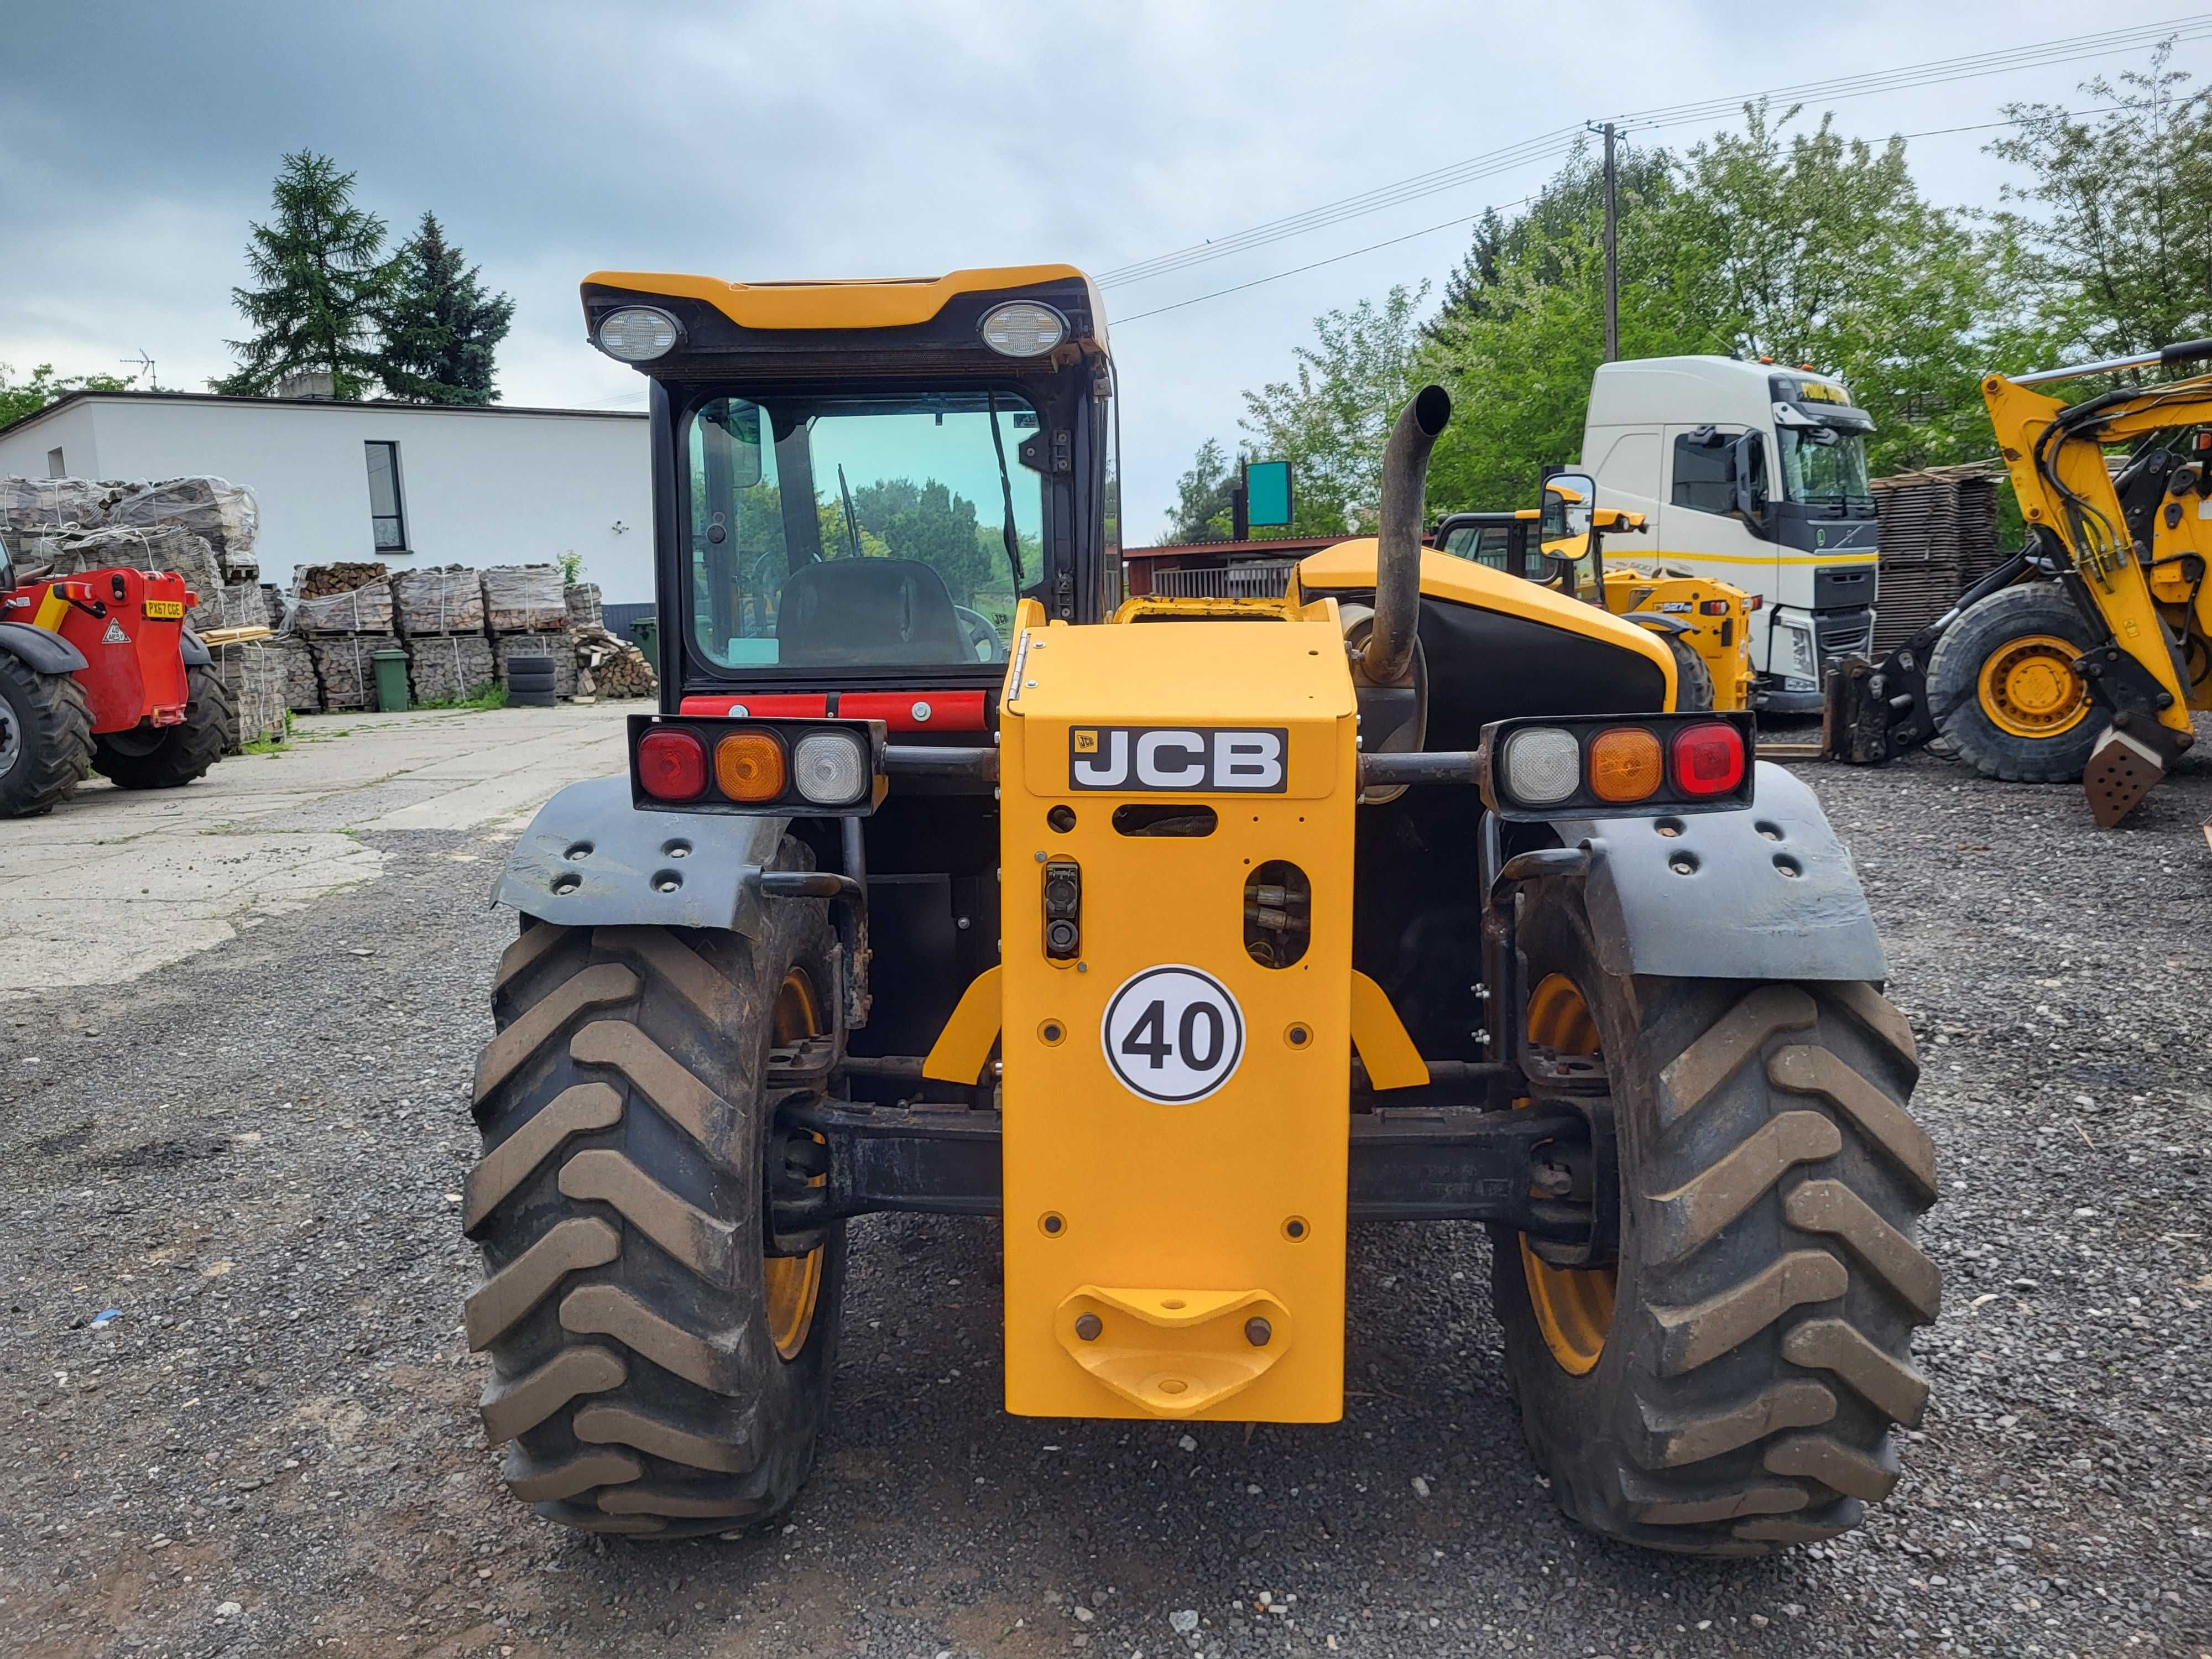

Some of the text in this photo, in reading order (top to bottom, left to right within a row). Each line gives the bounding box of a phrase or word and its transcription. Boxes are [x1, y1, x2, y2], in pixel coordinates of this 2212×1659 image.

[149, 602, 180, 615] PX67 CGE
[1663, 602, 1685, 612] 527
[1079, 735, 1094, 748] JCB
[1074, 731, 1282, 787] JCB
[1121, 1000, 1224, 1071] 40
